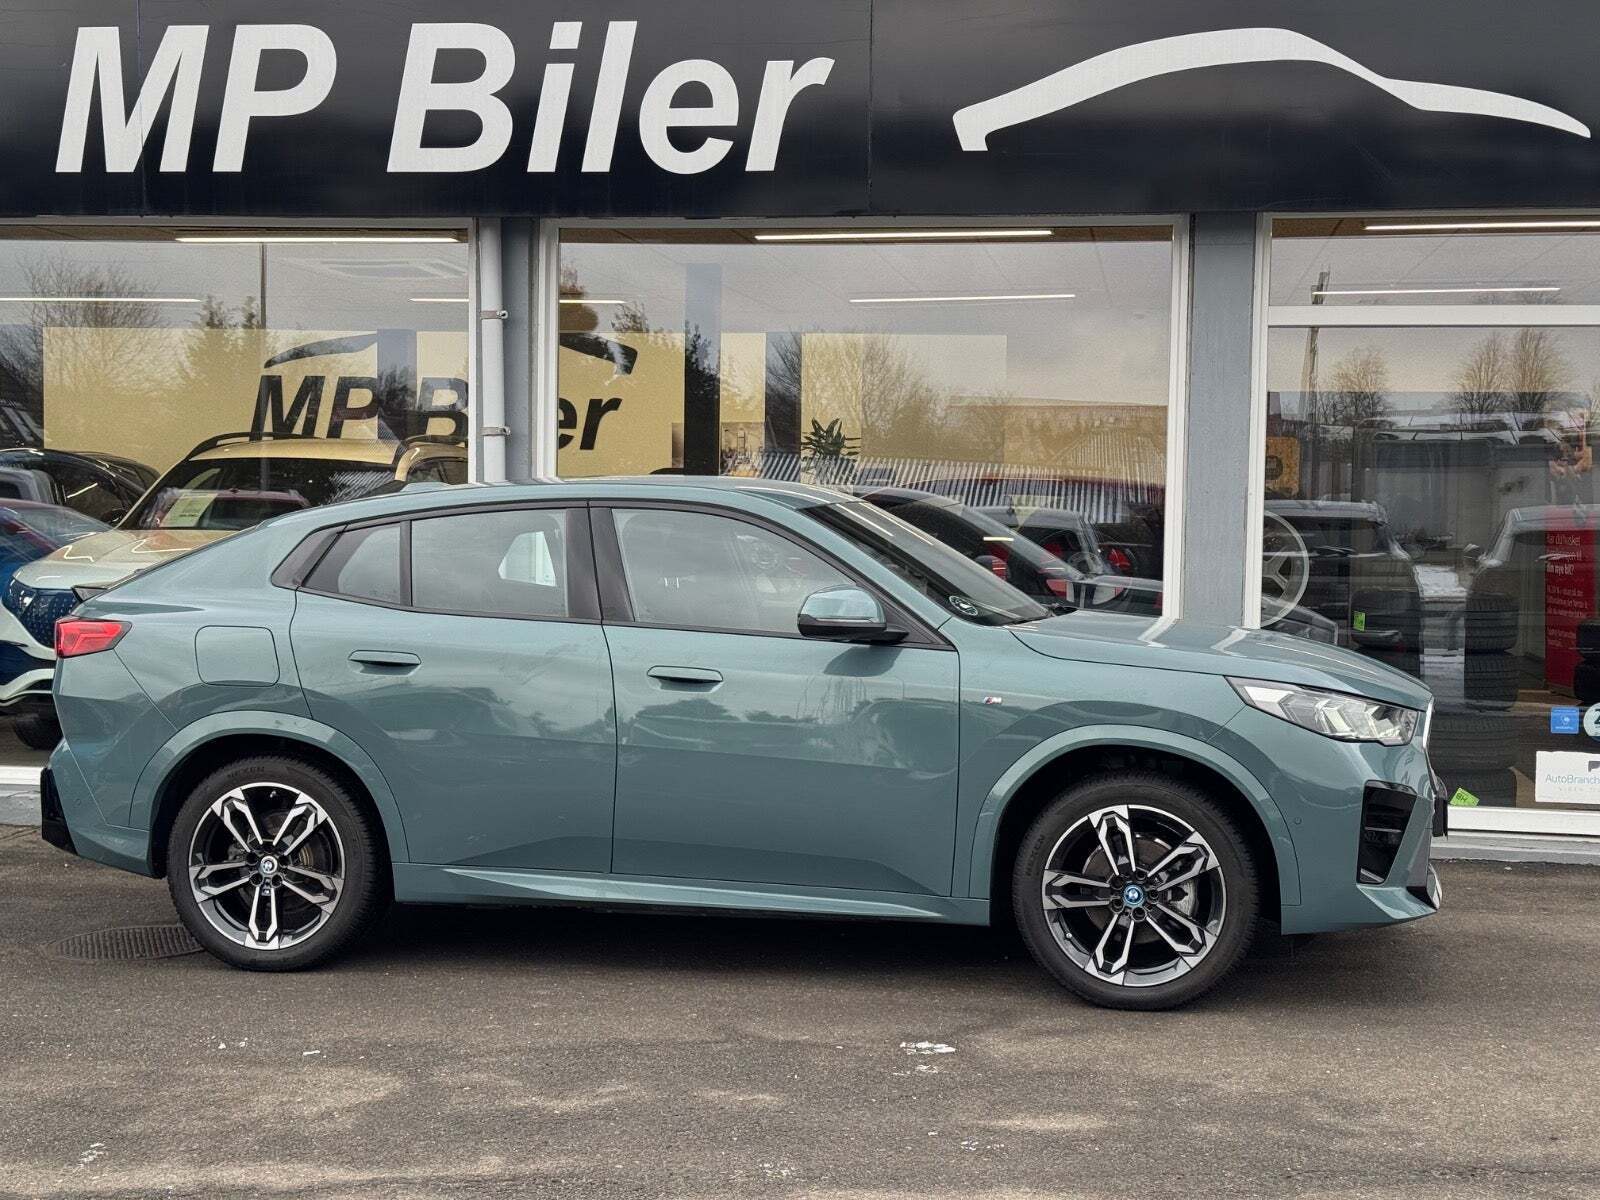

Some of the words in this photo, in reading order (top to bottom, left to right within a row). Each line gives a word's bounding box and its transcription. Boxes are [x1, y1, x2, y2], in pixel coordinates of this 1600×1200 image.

[55, 24, 338, 173] MP
[386, 20, 836, 175] Biler
[250, 374, 379, 441] MP
